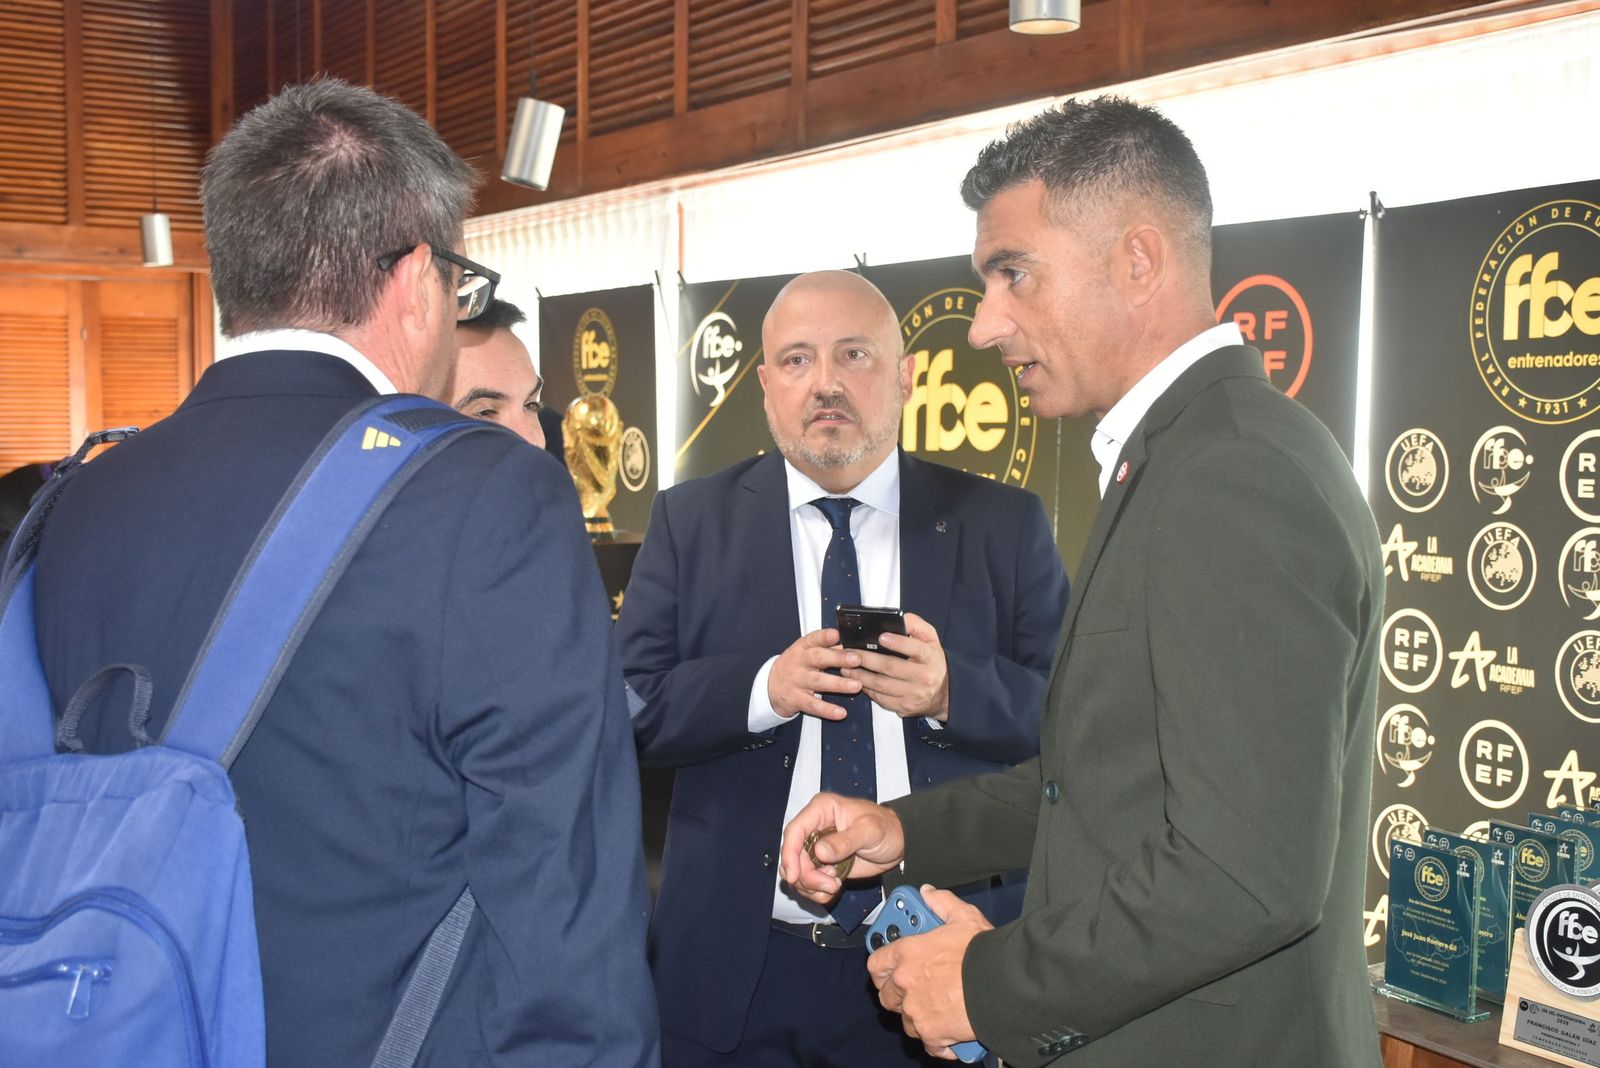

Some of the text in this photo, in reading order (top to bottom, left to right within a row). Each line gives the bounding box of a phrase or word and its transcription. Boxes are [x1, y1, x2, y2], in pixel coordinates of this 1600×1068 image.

[1551, 206, 1571, 219] DE
[944, 296, 964, 310] DE
[1537, 401, 1568, 415] 1931
[1400, 433, 1434, 451] UEFA
[1483, 527, 1520, 549] UEFA
[1489, 663, 1535, 688] ACADEMIA
[1527, 1019, 1559, 1034] FRANCISCO
[1561, 1030, 1580, 1040] GALÁN
[1582, 1037, 1597, 1046] DÍAZ
